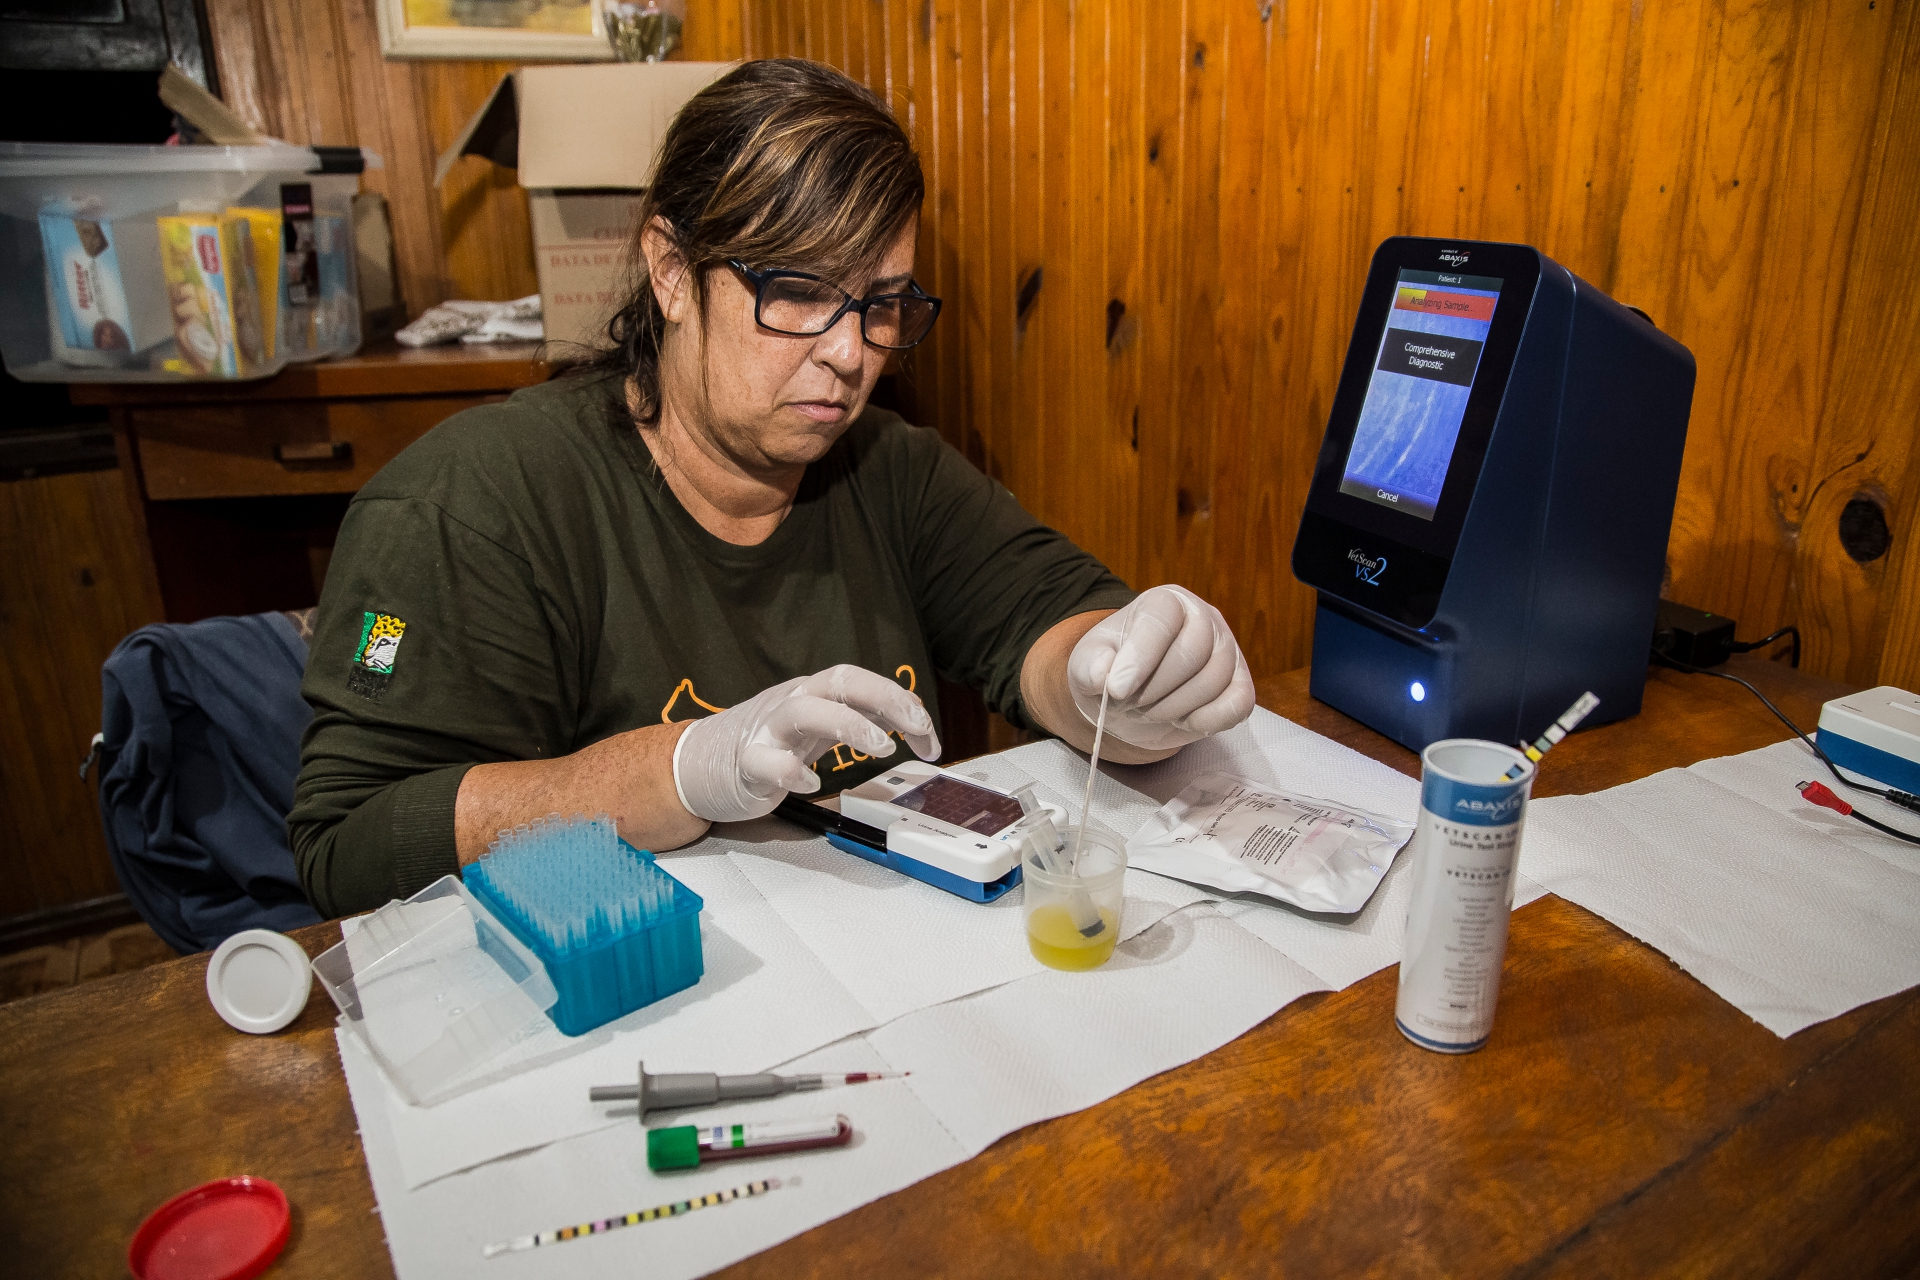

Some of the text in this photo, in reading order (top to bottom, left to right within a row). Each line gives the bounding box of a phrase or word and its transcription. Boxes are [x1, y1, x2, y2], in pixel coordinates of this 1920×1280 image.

[550, 254, 591, 267] DATA
[1439, 254, 1469, 262] ABAXIS
[554, 292, 594, 304] DATA
[1410, 297, 1441, 310] Analyzing
[1404, 343, 1456, 359] Comprehensive
[1408, 355, 1445, 370] Diagnostic
[1376, 488, 1399, 502] Cancel
[1347, 548, 1377, 569] VetScan
[1456, 798, 1521, 812] ABAXIS
[1434, 822, 1502, 841] VETSCAN
